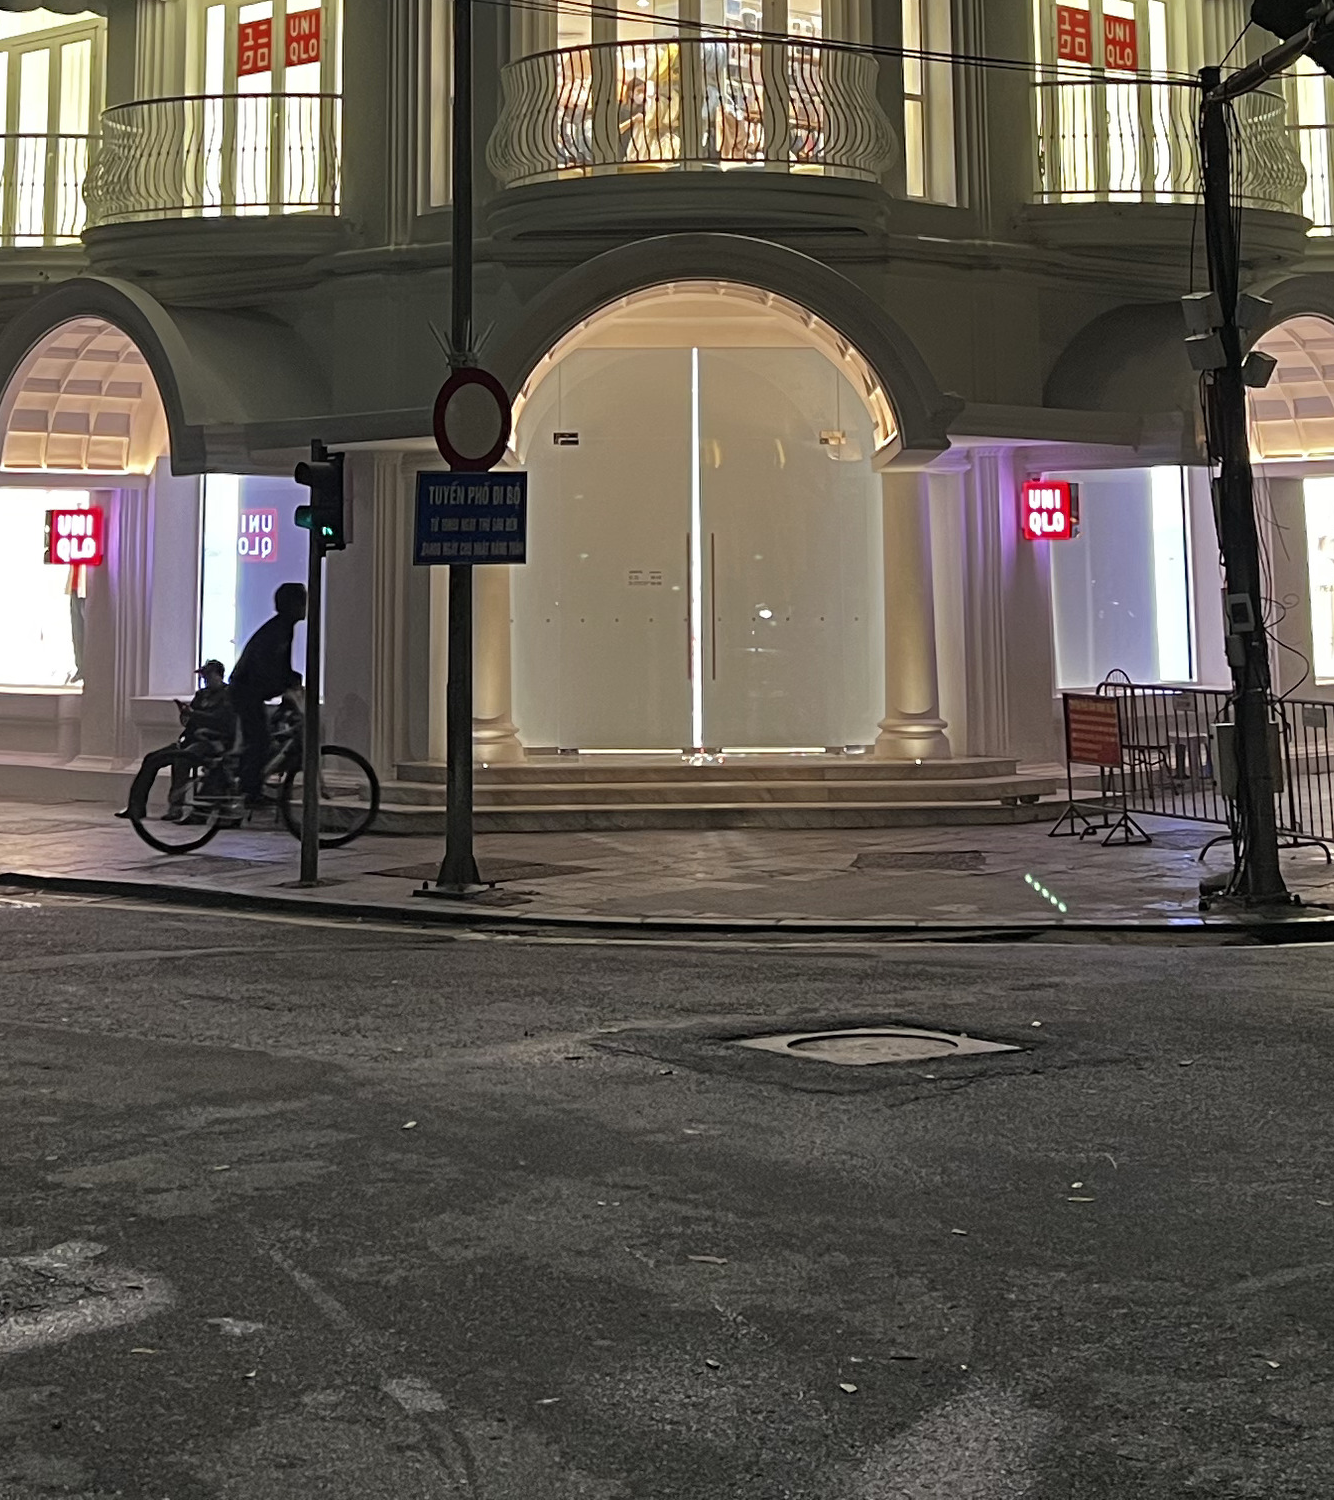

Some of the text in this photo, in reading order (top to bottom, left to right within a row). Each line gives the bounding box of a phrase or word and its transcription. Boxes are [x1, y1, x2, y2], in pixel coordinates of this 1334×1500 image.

[290, 14, 316, 37] UNI
[1106, 20, 1130, 43] UNI
[289, 38, 318, 63] QLO
[1107, 44, 1133, 67] QLO
[1028, 489, 1061, 510] UNI
[57, 514, 94, 536] UNI
[1029, 511, 1064, 536] QLO
[56, 537, 96, 563] QLO
